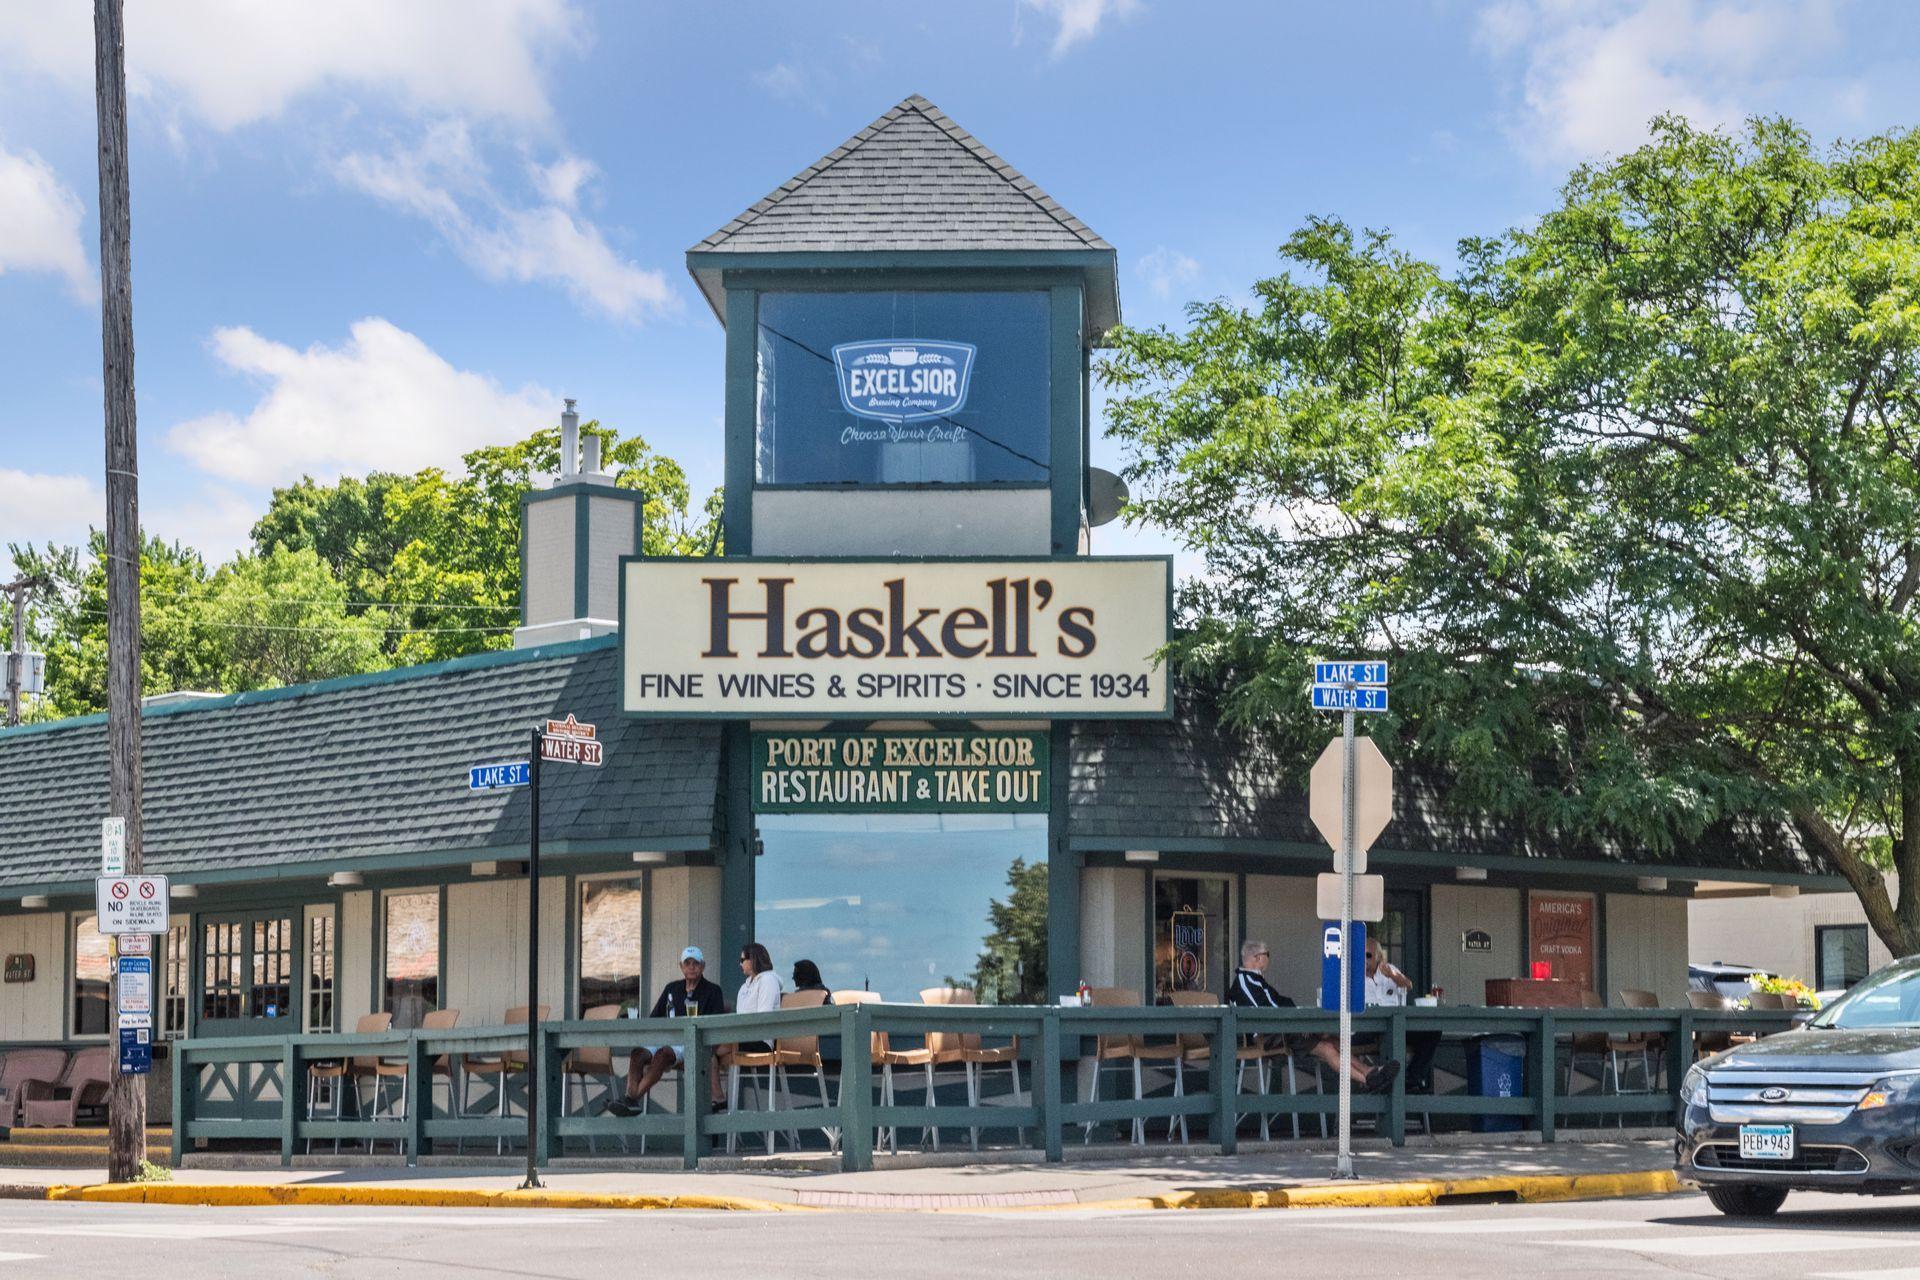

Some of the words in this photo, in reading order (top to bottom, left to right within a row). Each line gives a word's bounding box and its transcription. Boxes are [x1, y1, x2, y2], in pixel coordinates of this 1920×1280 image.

[851, 368, 957, 397] EXCELSIOR
[869, 397, 900, 407] Brewing
[902, 397, 937, 407] Company
[841, 426, 887, 445] Choose
[888, 427, 924, 442] Your
[927, 425, 968, 442] Craft
[701, 577, 1096, 659] Haskell's
[1323, 665, 1355, 682] LAKE
[1364, 665, 1379, 682] ST
[640, 673, 703, 698] FINE
[717, 673, 815, 698] WINES
[827, 673, 846, 698] &
[856, 673, 966, 698] SPIRITS
[992, 673, 1082, 698] SINCE
[1090, 673, 1150, 698] 1934
[1322, 689, 1357, 707] WATER
[1365, 691, 1378, 708] ST
[545, 739, 581, 760] WATER
[585, 745, 597, 762] ST
[768, 738, 836, 767] PORT
[842, 738, 874, 767] OF
[883, 738, 1034, 767] EXCELSIOR
[478, 767, 505, 786] LAKE
[509, 766, 522, 782] ST
[761, 770, 910, 802] RESTAURANT
[916, 778, 931, 800] &
[935, 770, 991, 802] TAKE
[996, 770, 1042, 803] OUT
[108, 902, 123, 912] NO
[1539, 902, 1582, 914] AMERICA'S
[1540, 945, 1560, 954] CRAFT
[1561, 945, 1582, 954] VODKA
[1743, 1134, 1763, 1150] PEB
[1771, 1134, 1790, 1150] 943
